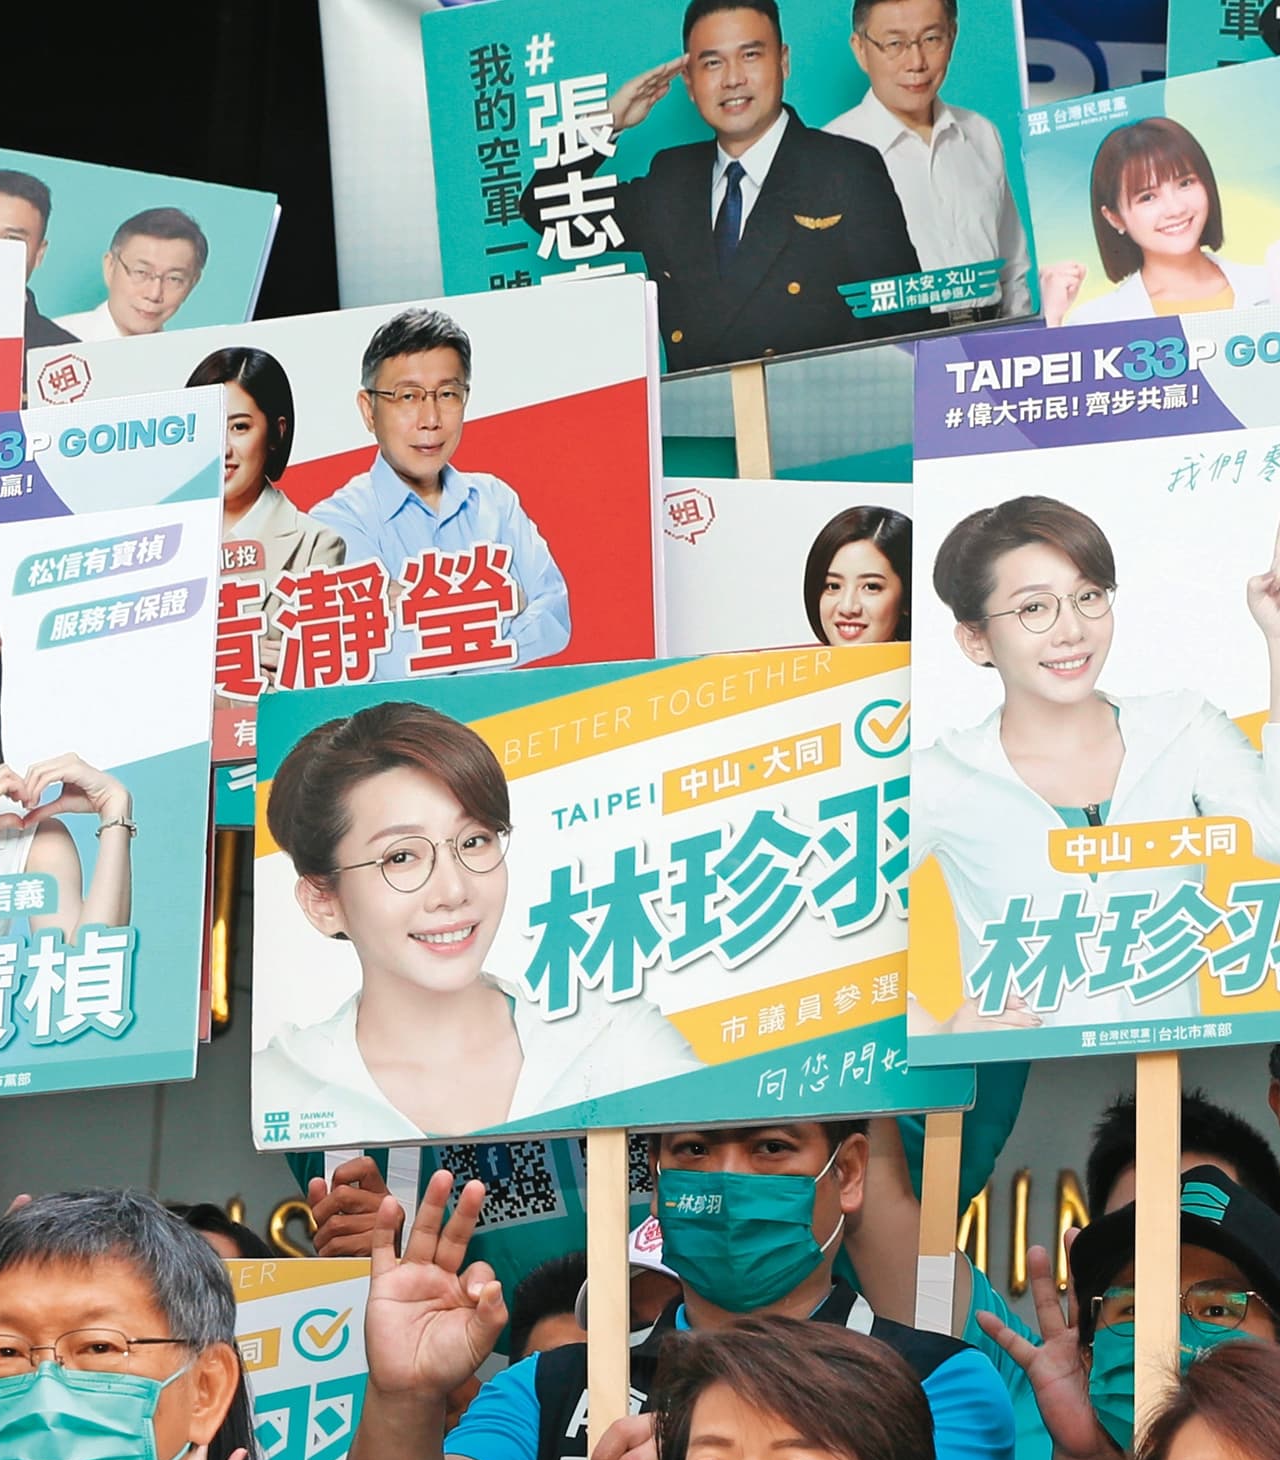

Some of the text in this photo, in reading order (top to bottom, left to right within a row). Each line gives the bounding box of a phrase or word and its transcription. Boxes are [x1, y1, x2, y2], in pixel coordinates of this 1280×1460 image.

[524, 33, 627, 290] #張志
[945, 354, 1084, 394] TAIPEI
[57, 414, 197, 458] GOING!
[26, 533, 166, 588] 松信有寶楨
[48, 588, 191, 643] 服務有保證
[502, 648, 834, 767] BETTER TOGETHER
[680, 734, 826, 800] 中山・大同
[551, 781, 658, 833] TAIPEI
[1065, 823, 1239, 867] 中山・大同
[299, 1110, 335, 1122] TAIWAN
[299, 1130, 326, 1141] PARTY
